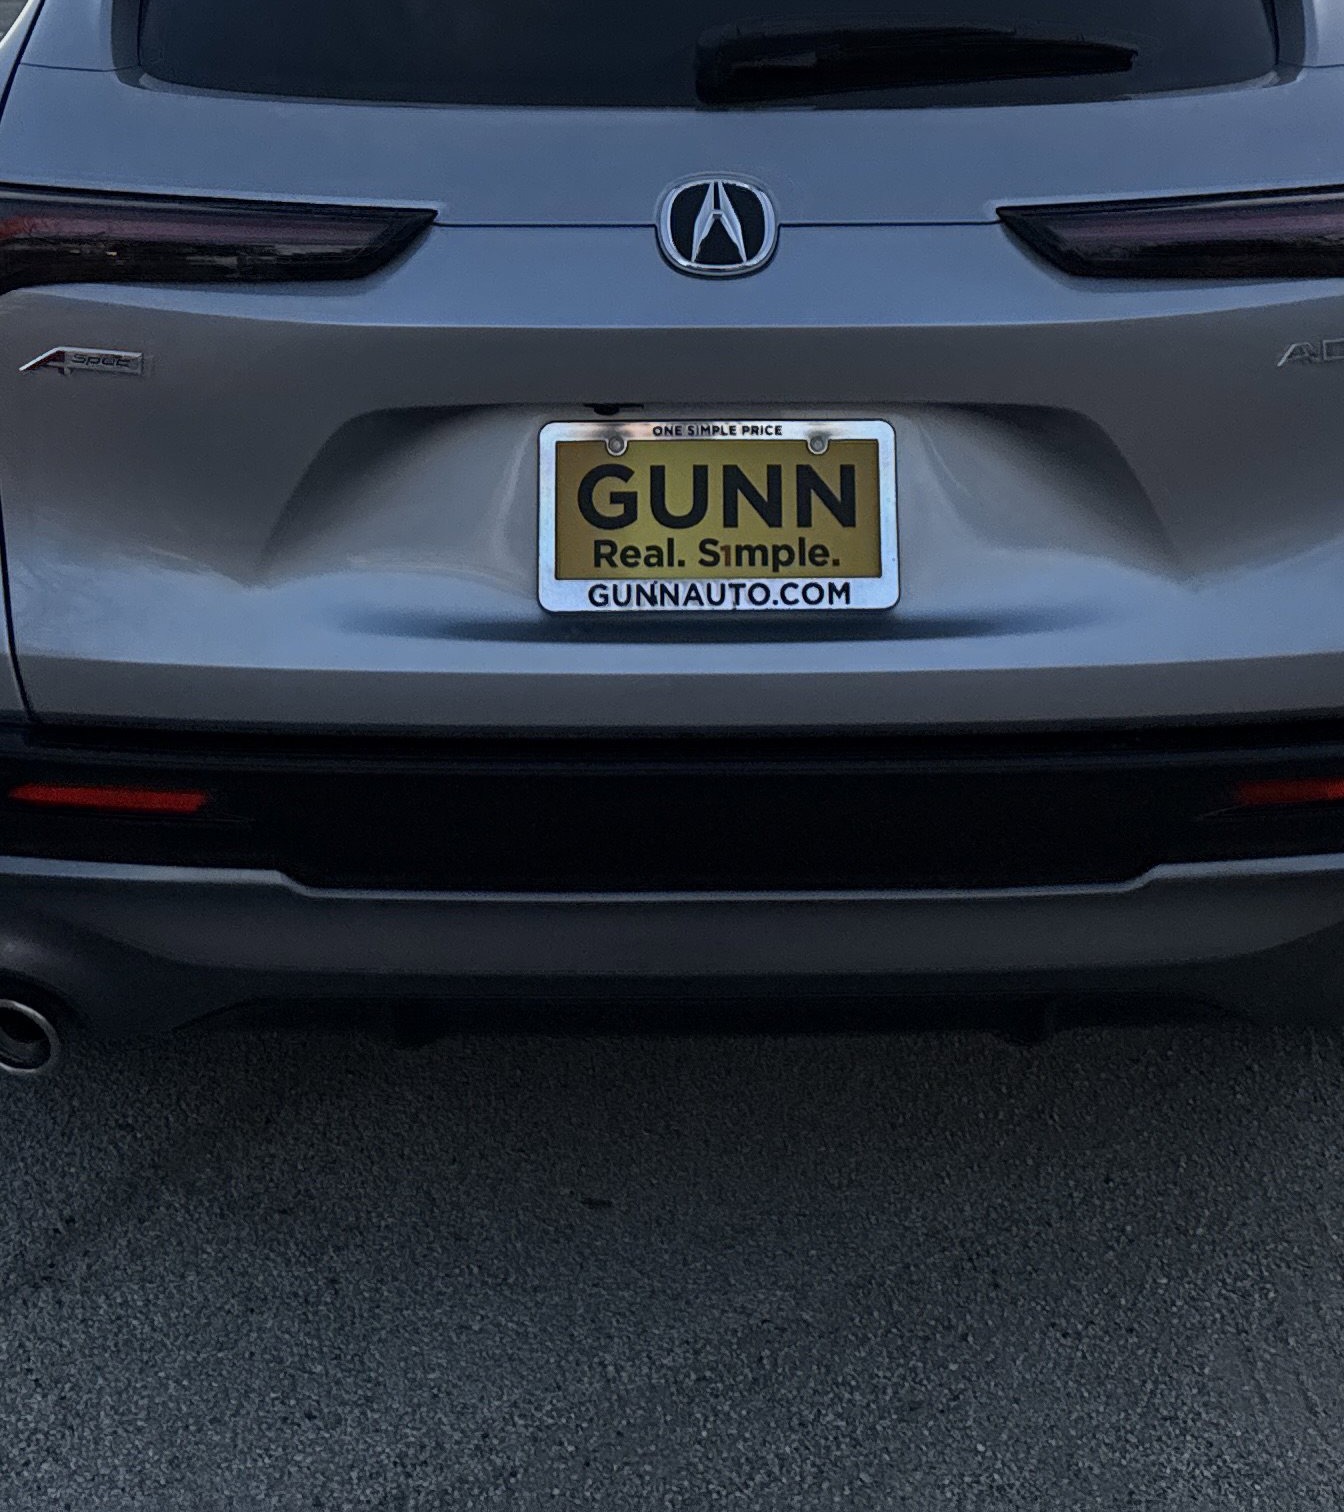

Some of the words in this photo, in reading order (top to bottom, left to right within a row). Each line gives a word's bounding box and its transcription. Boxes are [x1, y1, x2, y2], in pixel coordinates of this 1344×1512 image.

[652, 425, 683, 437] ONE
[687, 425, 737, 437] SIMPLE
[741, 424, 783, 436] PRICE
[577, 463, 856, 530] GUNN
[593, 537, 686, 569] Real.
[588, 581, 851, 607] GUNNAUTO.COM
